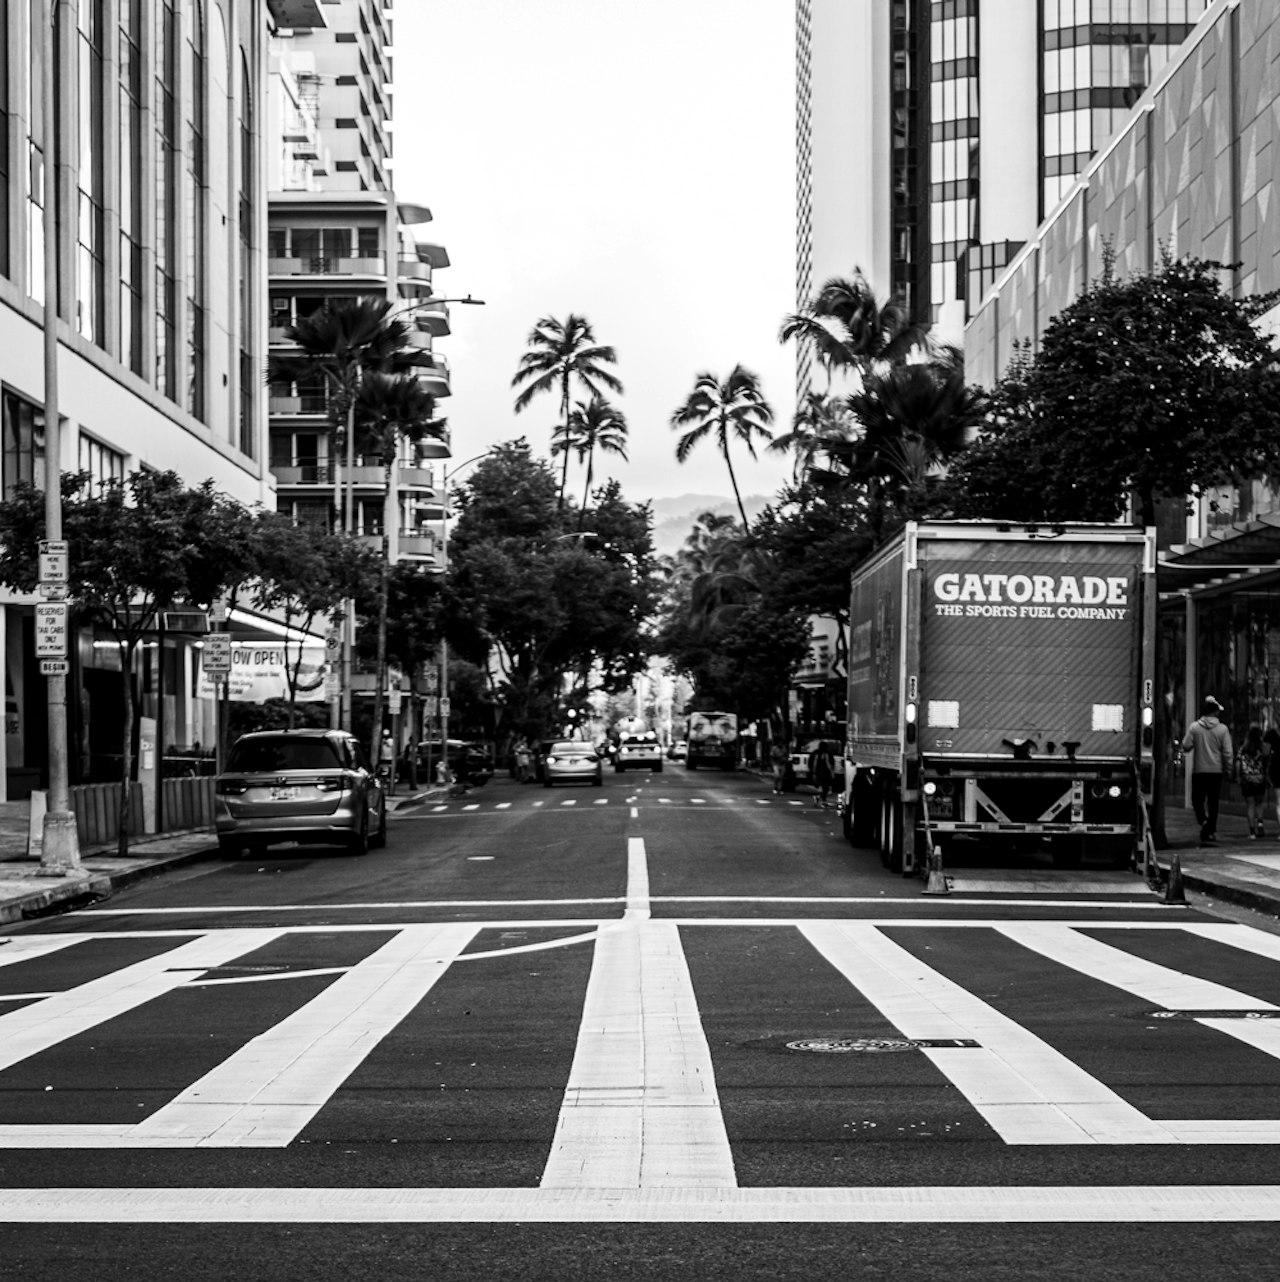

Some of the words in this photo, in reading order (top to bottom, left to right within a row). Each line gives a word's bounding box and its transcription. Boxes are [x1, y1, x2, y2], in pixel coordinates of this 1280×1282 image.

[933, 573, 1129, 605] GATORADE
[37, 607, 65, 616] RESERVED
[935, 604, 963, 616] THE
[966, 605, 1017, 617] SPORTS
[1020, 606, 1055, 618] FUEL
[1057, 607, 1127, 620] COMPANY
[45, 617, 56, 625] FOR
[233, 650, 251, 665] OW
[255, 650, 284, 666] OPEN
[43, 663, 66, 671] BEGIN
